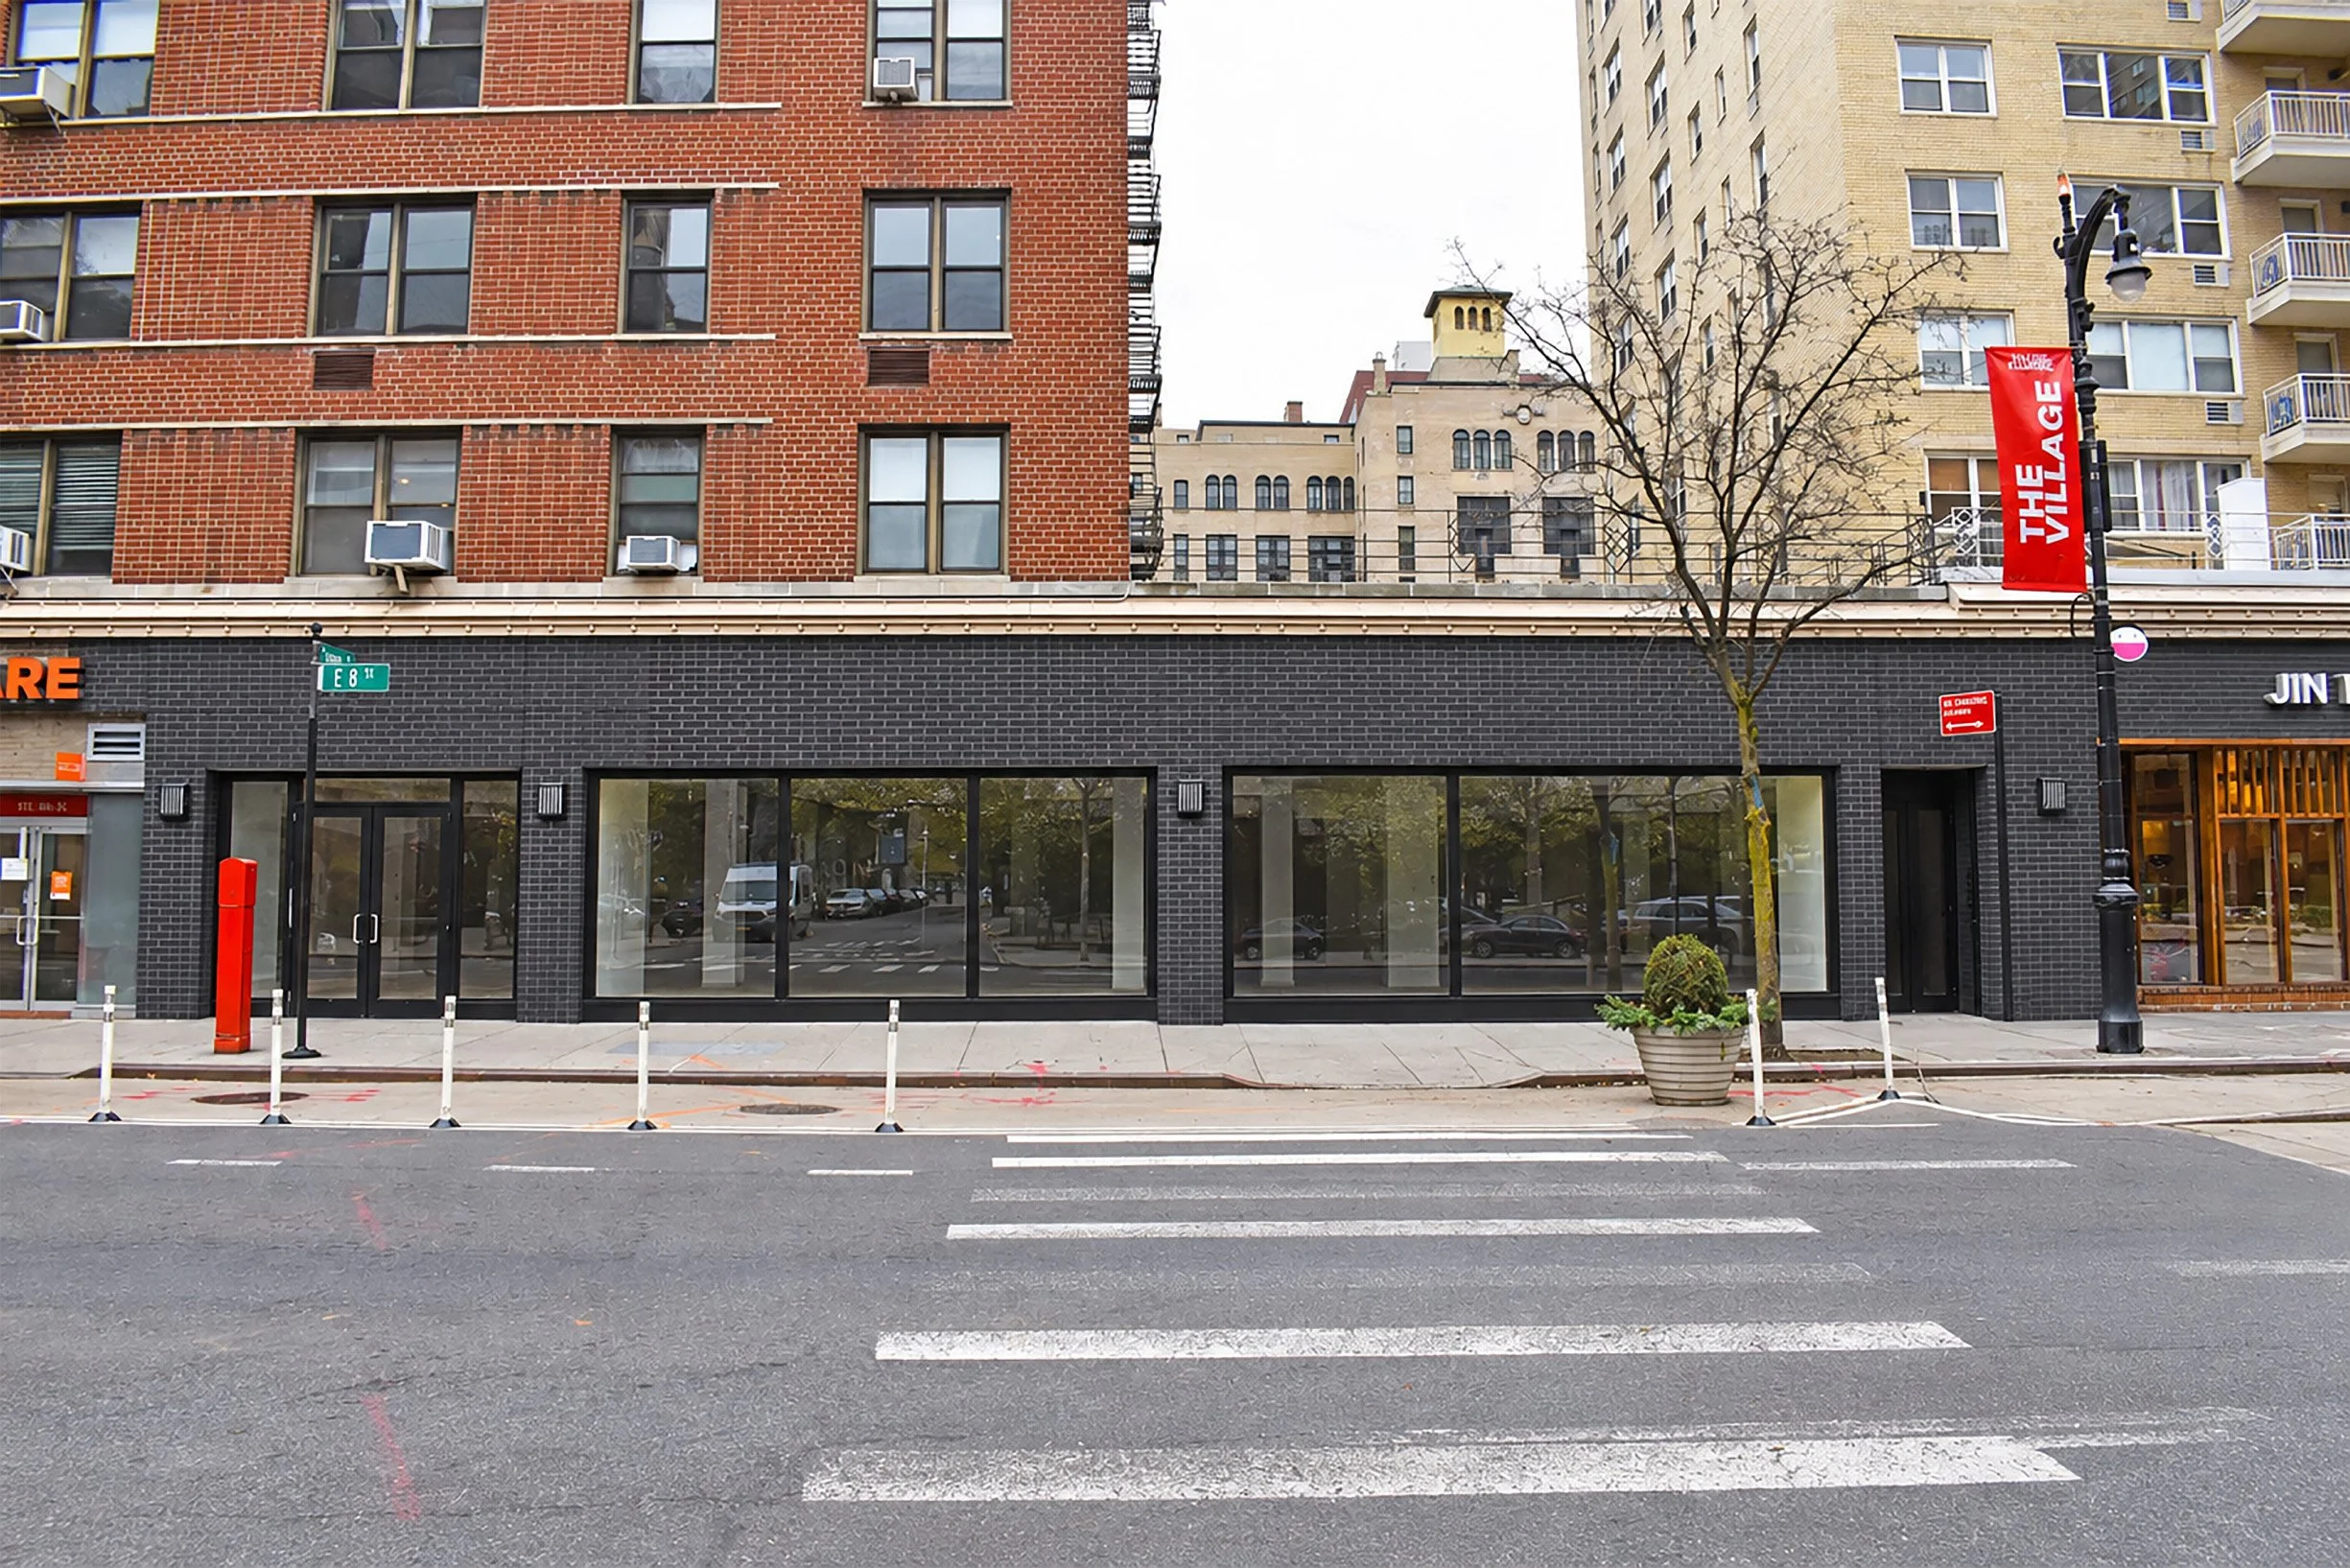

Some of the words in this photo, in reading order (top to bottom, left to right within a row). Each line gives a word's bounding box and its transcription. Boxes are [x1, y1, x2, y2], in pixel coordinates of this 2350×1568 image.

[2034, 381, 2069, 544] VILLAGE
[2015, 464, 2045, 544] THE
[0, 656, 81, 699] RE
[334, 667, 343, 688] E
[348, 667, 358, 688] 8
[2264, 672, 2328, 704] JIN
